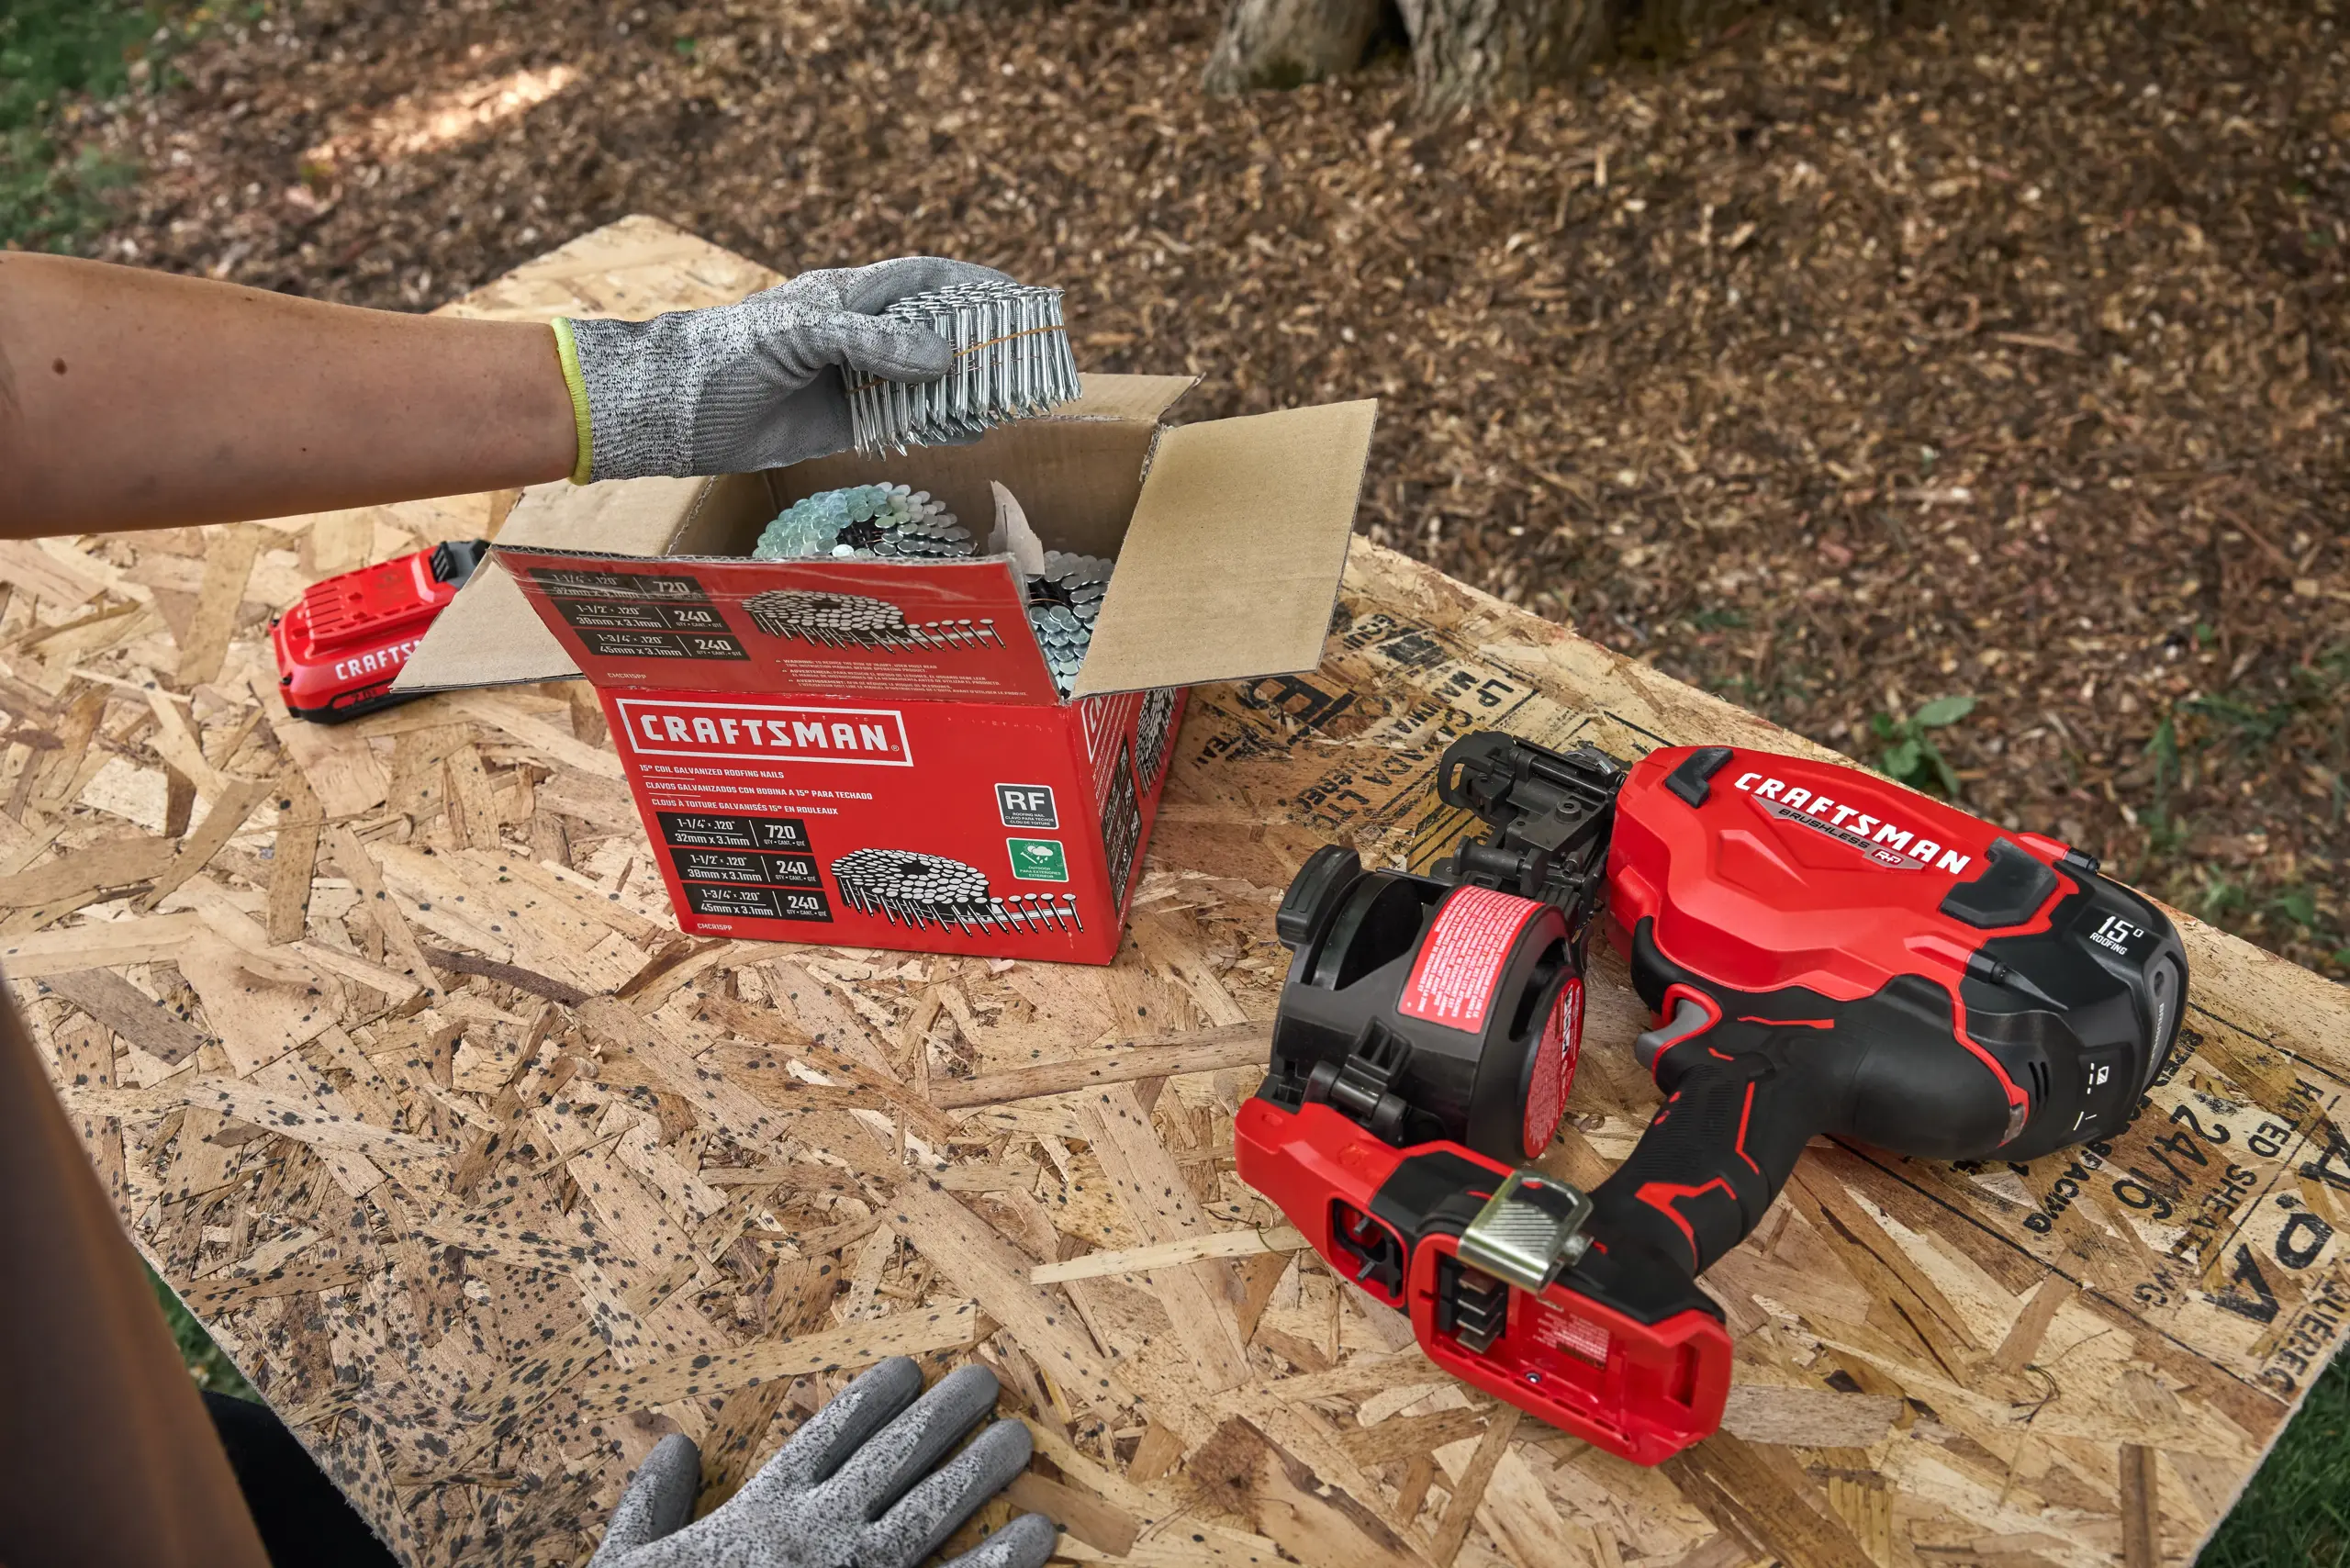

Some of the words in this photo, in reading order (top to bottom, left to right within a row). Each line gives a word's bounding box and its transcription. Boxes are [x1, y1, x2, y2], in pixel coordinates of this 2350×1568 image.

[653, 580, 689, 593] 720
[576, 617, 615, 626] 38mm
[624, 619, 663, 629] 3.1mm
[675, 610, 711, 622] 240
[599, 645, 634, 655] 45mm
[644, 647, 683, 657] 3.1mm
[695, 639, 733, 651] 240
[335, 640, 421, 681] CRAFTS
[640, 714, 889, 752] CRAFTSMAN
[655, 765, 673, 773] COIL
[674, 767, 723, 776] GALVANIZED
[723, 768, 759, 778] ROOFING
[760, 770, 785, 778] NAILS
[645, 781, 676, 790] CLAVOS
[677, 783, 737, 793] GALVANIZADOS
[755, 787, 788, 796] BOBINA
[811, 790, 834, 798] PARA
[834, 790, 873, 801] TECHADO
[651, 798, 677, 807] CLOUS
[685, 800, 718, 809] TOITURE
[719, 801, 767, 812] GALVANISÉS
[796, 806, 839, 815] ROULEAUX
[1004, 790, 1045, 811] RF
[677, 818, 705, 829] 1-1/4"
[713, 821, 735, 831] .120"
[1733, 771, 1972, 875] CRAFTSMAN
[1778, 808, 1871, 849] BRUSHLESS
[765, 824, 796, 840] 720
[675, 833, 707, 844] 32mm
[716, 834, 750, 846] 3.1mm
[690, 854, 718, 866] 1-1/2"
[726, 857, 747, 867] .120"
[776, 860, 808, 875] 240
[688, 868, 720, 879] 38mm
[729, 870, 763, 882] 3.1mm
[701, 889, 732, 901] 1-3/4"
[739, 891, 760, 902] .120"
[788, 895, 820, 910] 240
[700, 903, 733, 913] 45mm
[742, 905, 774, 916] 3.1mm
[697, 922, 733, 931] CMCR15PP
[2089, 932, 2128, 956] ROOFING
[2111, 1104, 2231, 1220] 24/16
